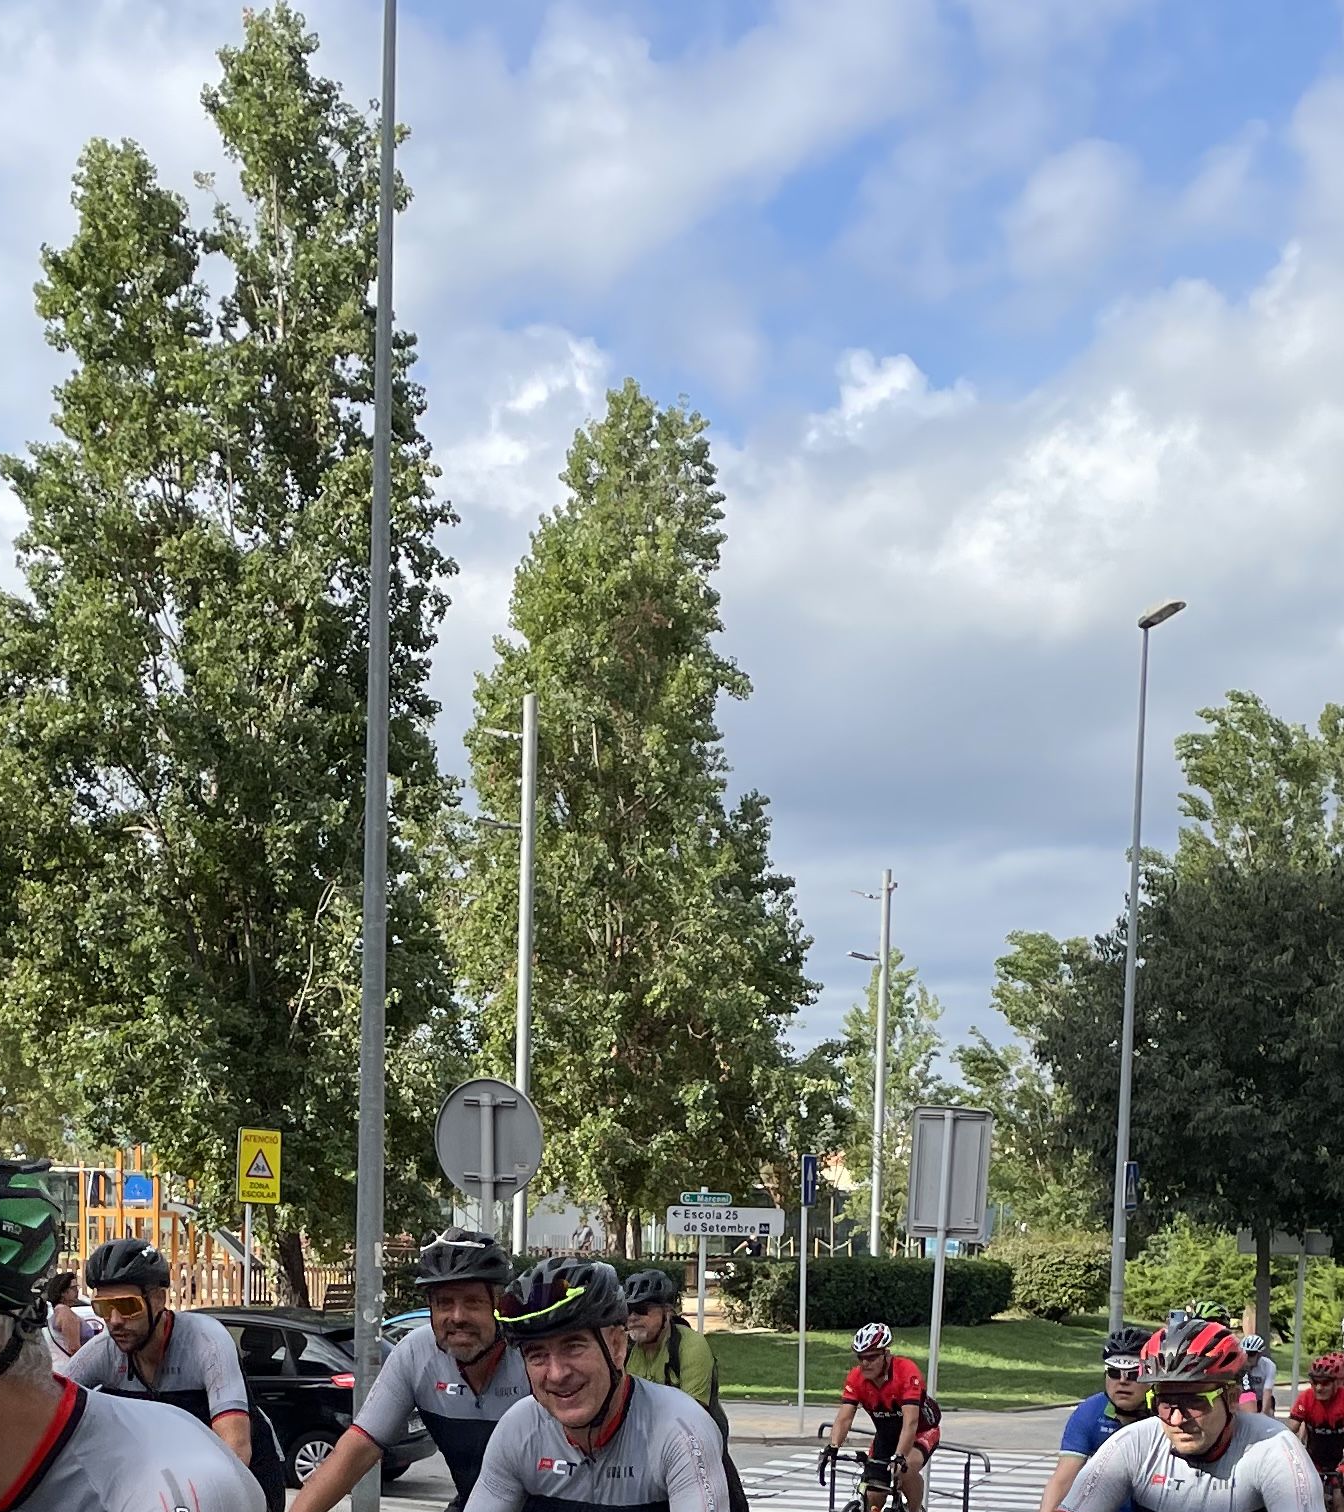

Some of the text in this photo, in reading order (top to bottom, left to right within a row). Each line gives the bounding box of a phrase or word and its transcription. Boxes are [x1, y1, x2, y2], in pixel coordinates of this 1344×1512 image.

[243, 1134, 279, 1145] ATENCIÓ
[249, 1182, 269, 1190] ZONA
[242, 1190, 276, 1198] ESCOLAR
[684, 1209, 738, 1220] Escola 25
[684, 1222, 756, 1233] de Setembre
[537, 1458, 577, 1477] PCT
